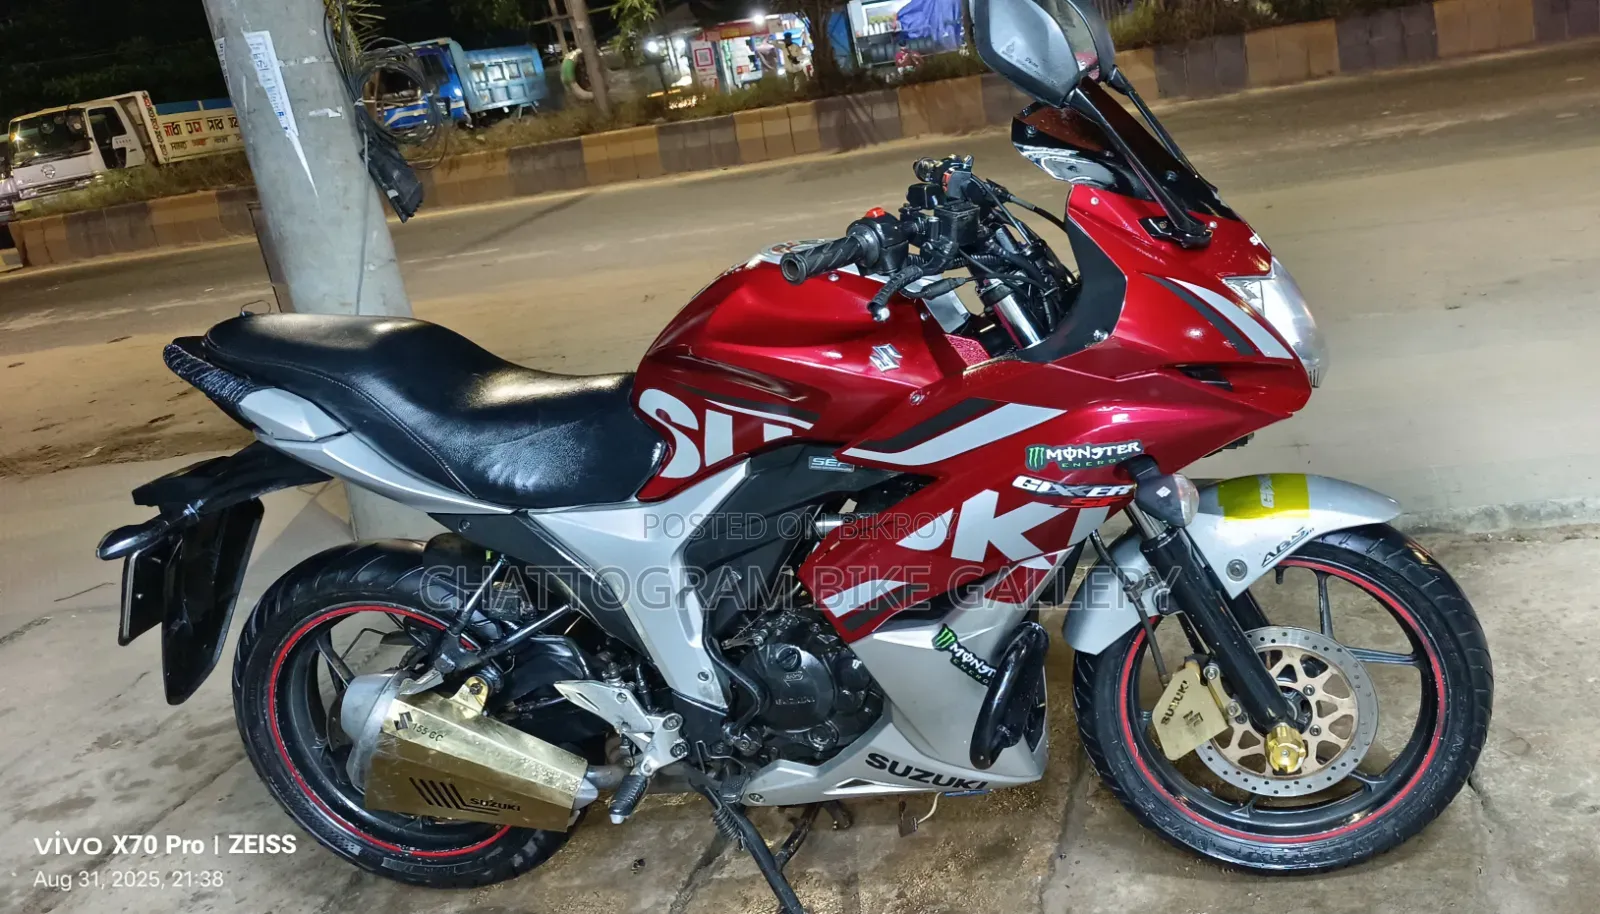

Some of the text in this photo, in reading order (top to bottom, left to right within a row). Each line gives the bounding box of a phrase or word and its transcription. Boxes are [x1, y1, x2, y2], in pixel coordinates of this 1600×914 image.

[1046, 441, 1141, 461] MONSTER
[949, 642, 997, 677] MONST
[953, 658, 989, 684] ENERG
[411, 722, 428, 735] 155
[865, 752, 989, 790] SUZUKI
[470, 797, 521, 812] SUZUKI
